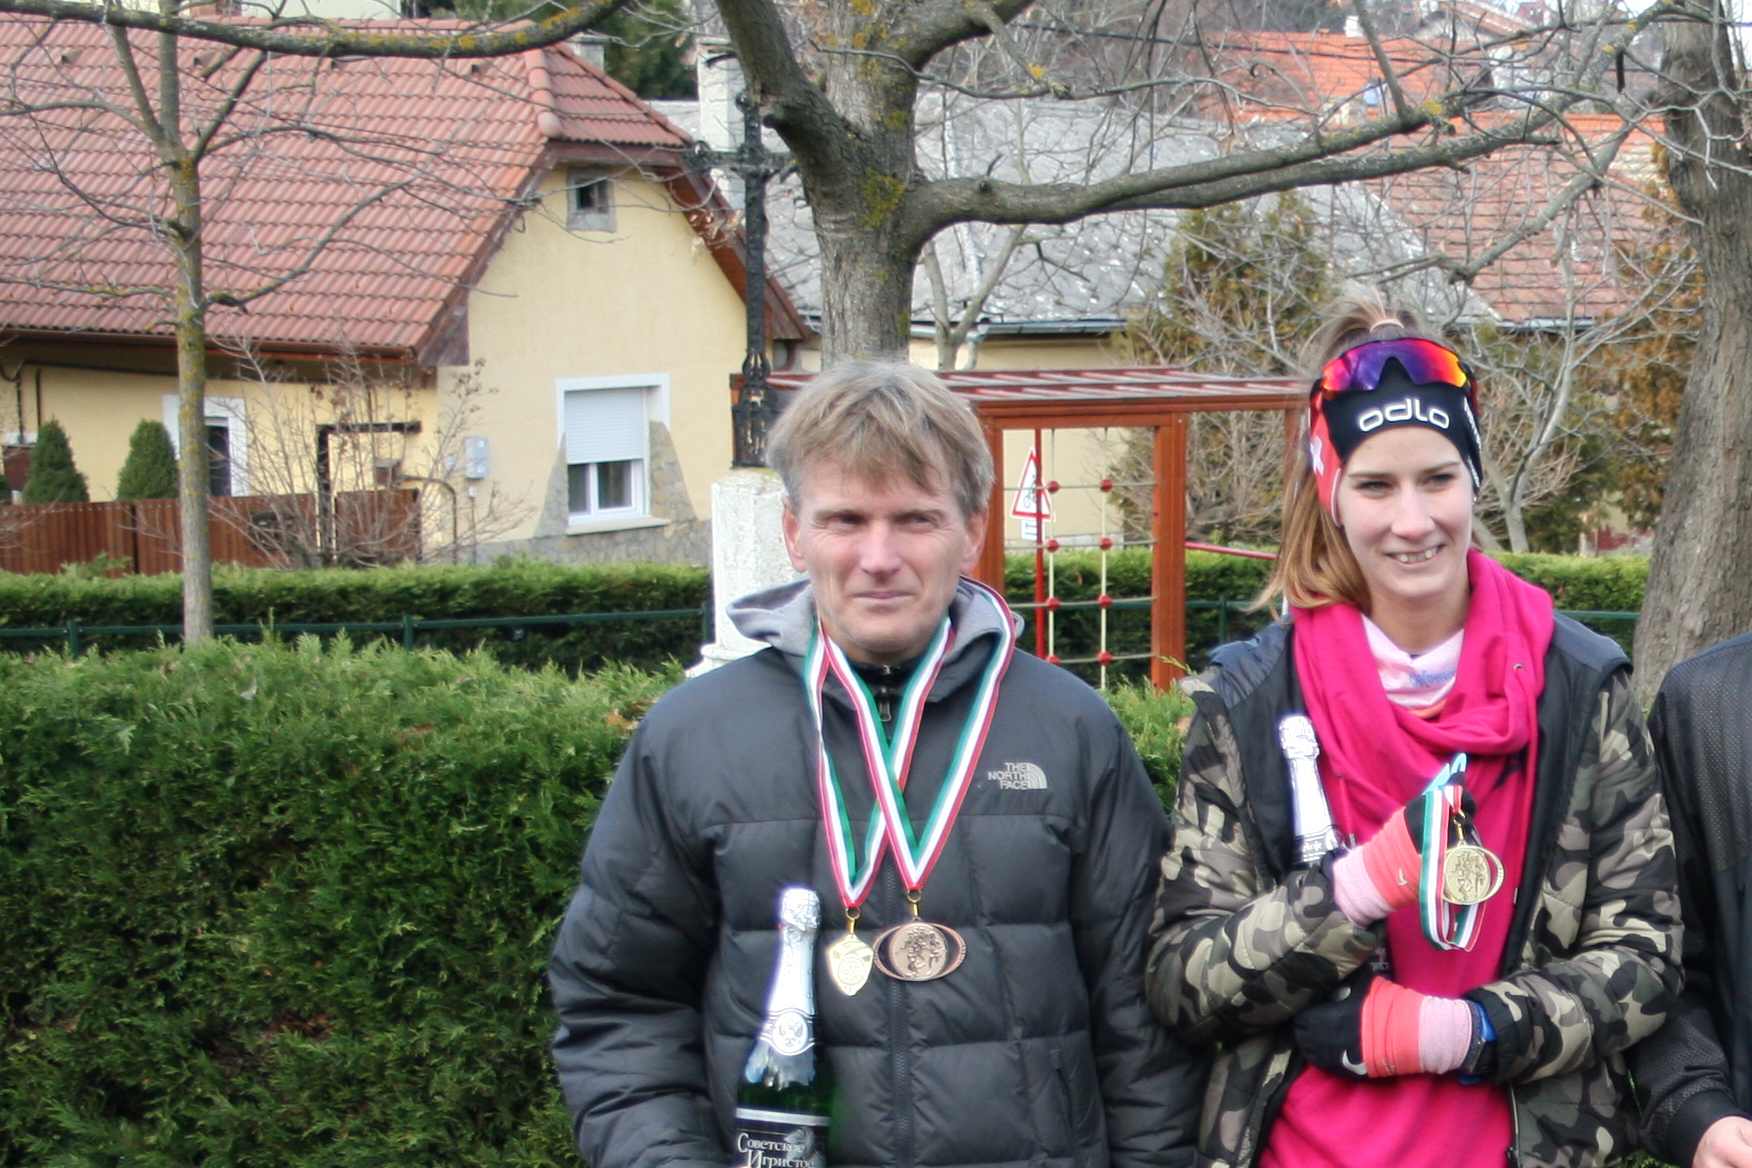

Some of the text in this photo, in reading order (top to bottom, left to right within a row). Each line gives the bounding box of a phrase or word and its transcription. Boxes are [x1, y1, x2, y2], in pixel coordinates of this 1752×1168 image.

[1359, 399, 1449, 432] odlo
[1004, 762, 1027, 771] THE
[988, 771, 1027, 780] NORTH
[1000, 780, 1027, 789] FACE
